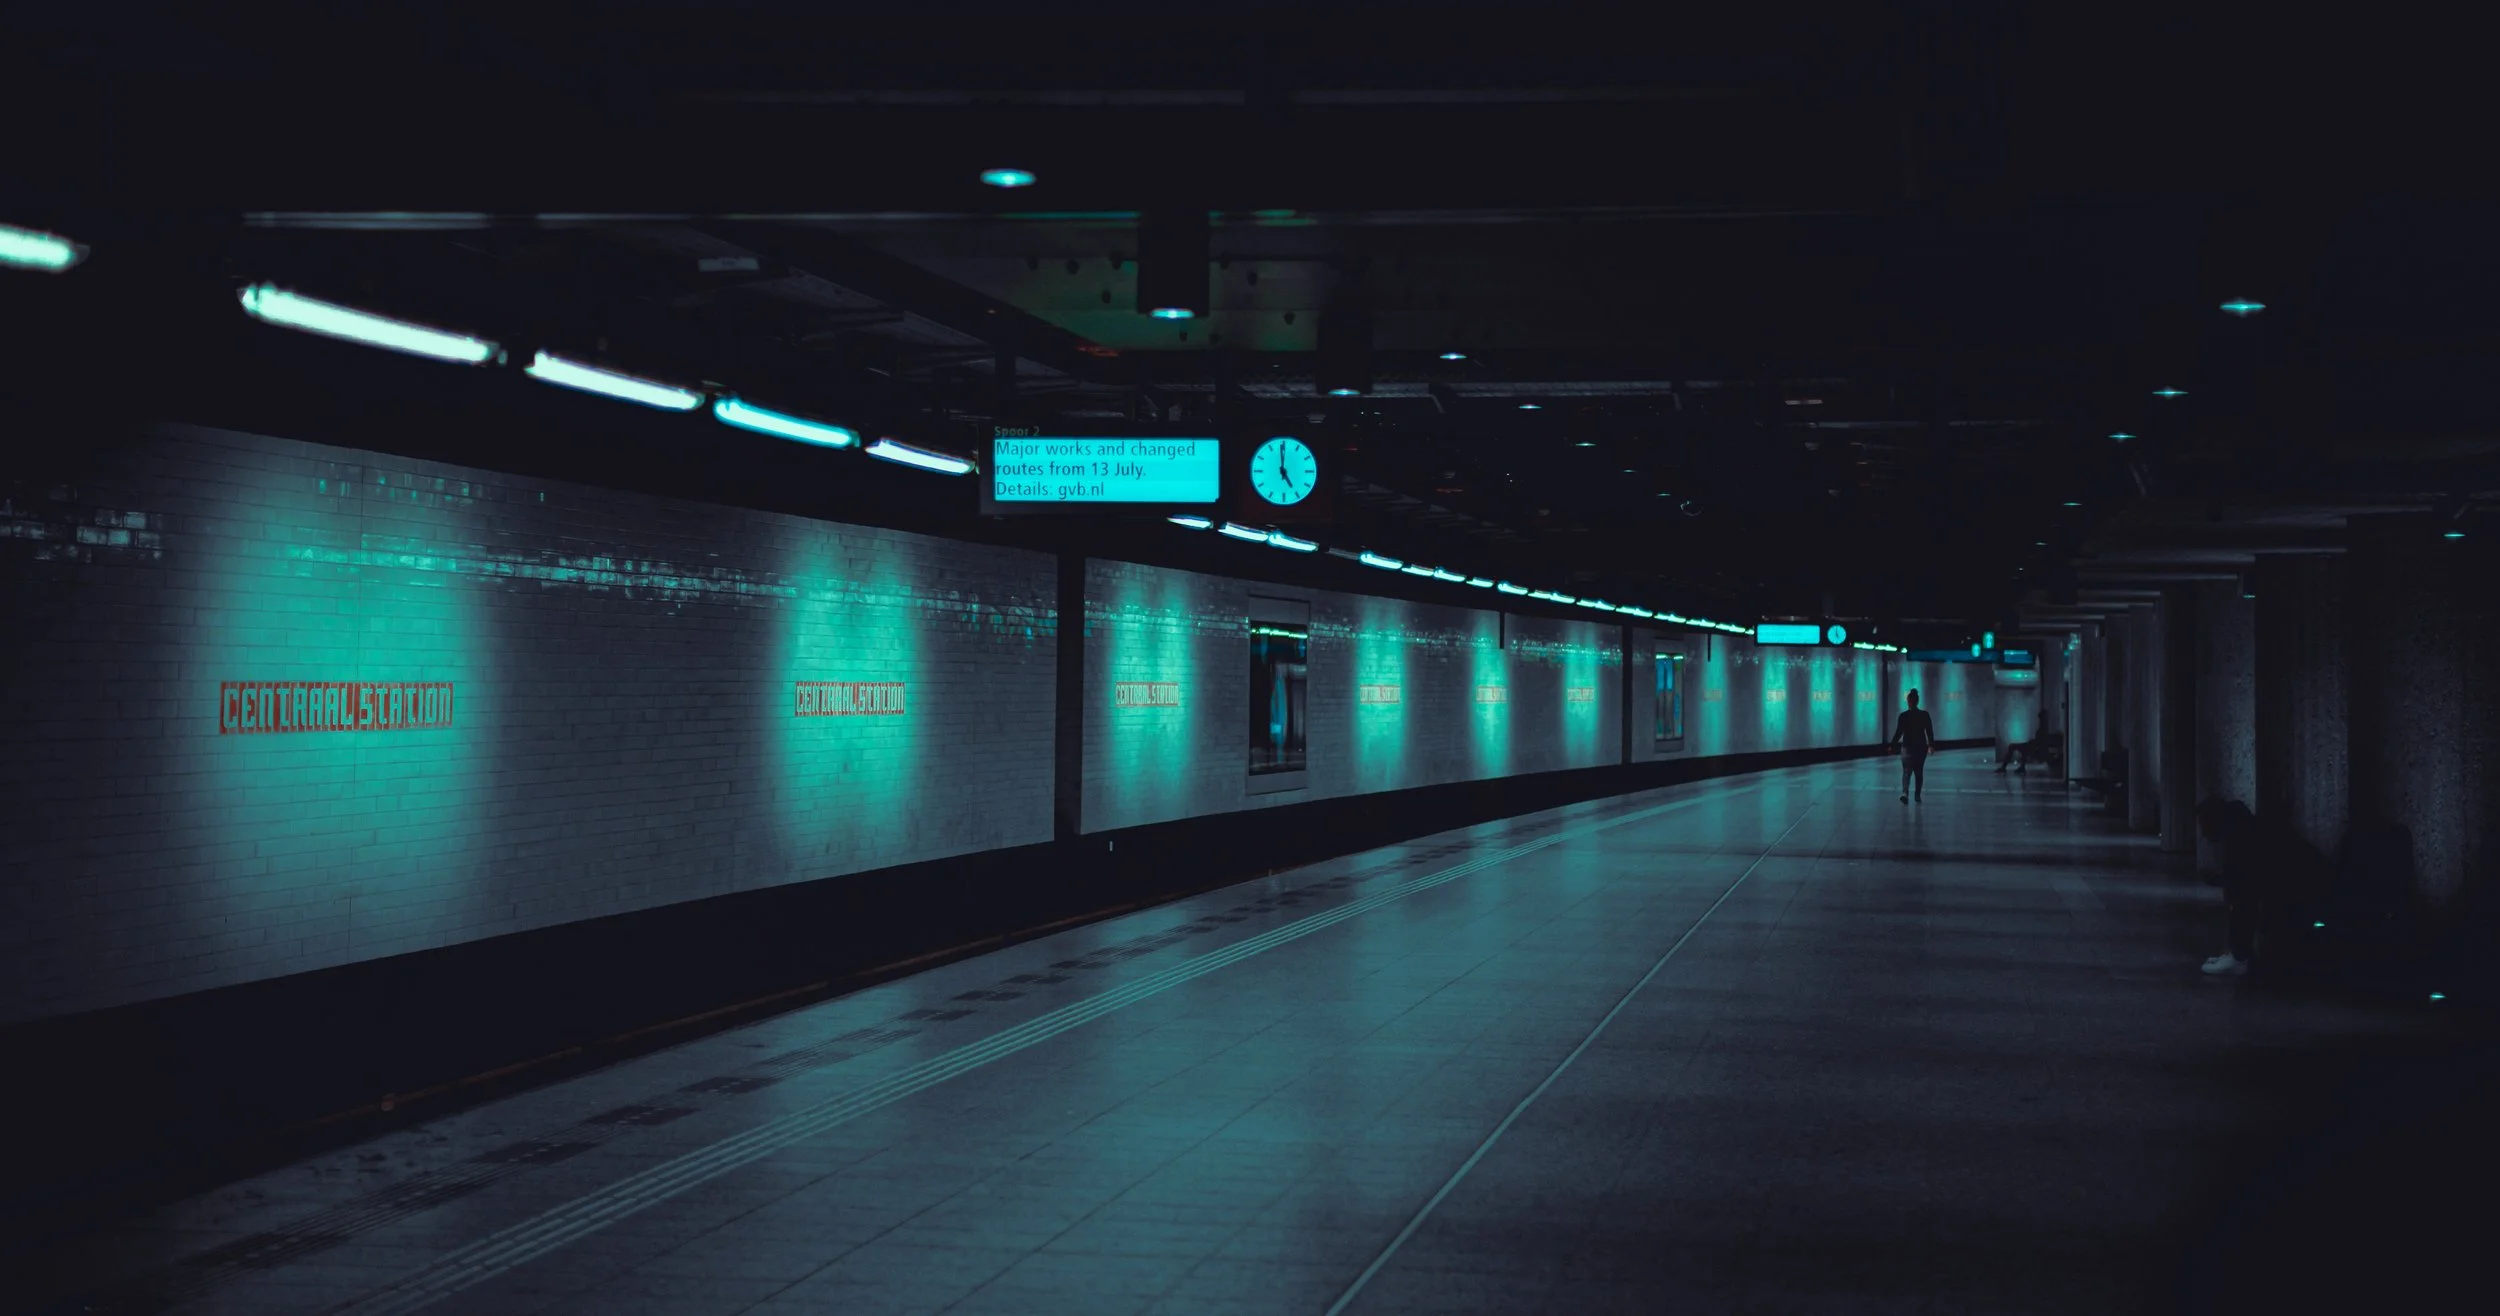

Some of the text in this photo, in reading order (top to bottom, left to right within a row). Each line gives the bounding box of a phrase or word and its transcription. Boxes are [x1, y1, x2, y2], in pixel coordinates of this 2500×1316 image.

[994, 426, 1040, 438] Spoor 2
[996, 441, 1196, 460] Major works and changed
[997, 461, 1146, 480] routes from 13 July.
[997, 481, 1104, 500] Details: gvb.nl
[223, 687, 450, 728] CENTRAAL STATION
[859, 686, 904, 711] STATION
